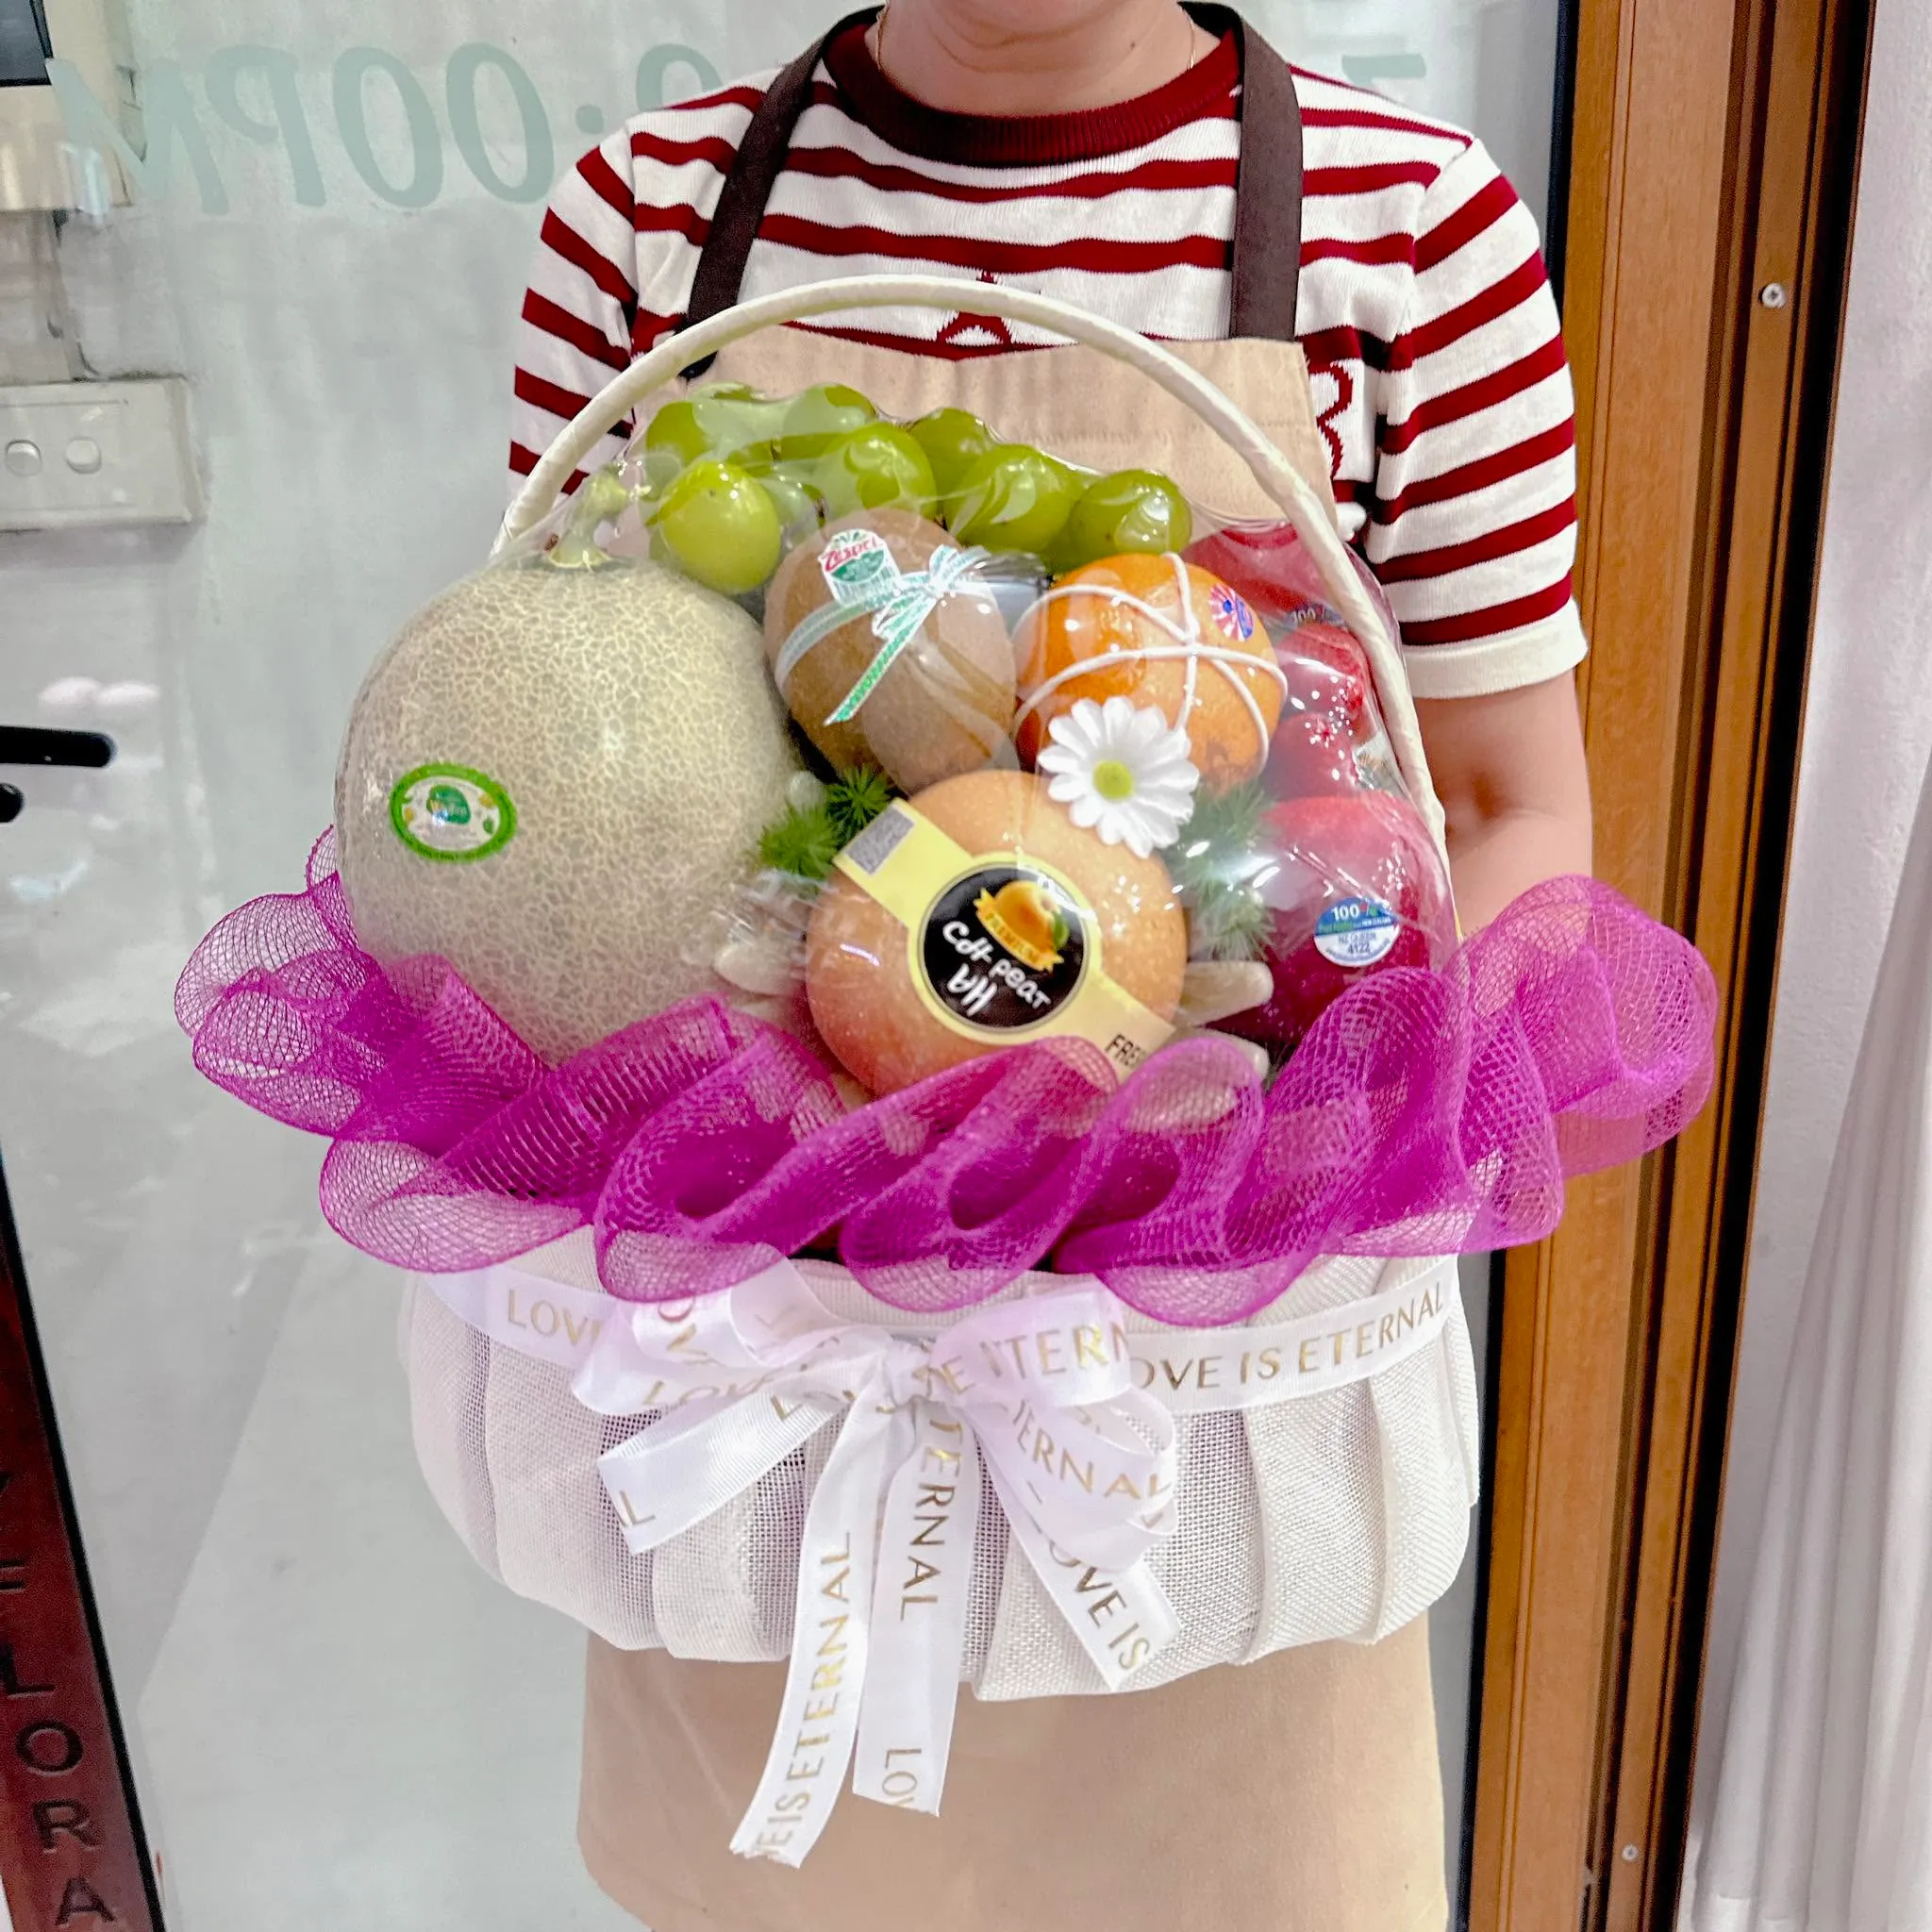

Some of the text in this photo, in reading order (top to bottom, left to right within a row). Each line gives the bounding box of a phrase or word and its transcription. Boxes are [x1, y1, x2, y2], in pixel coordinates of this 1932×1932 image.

[508, 1289, 603, 1348] LOV
[1131, 1281, 1444, 1391] OVE IS ETERNAL
[900, 1415, 963, 1622] TERNAL
[786, 1531, 852, 1782] ETERNAL
[1108, 1622, 1151, 1671] IS
[767, 1793, 812, 1824] IS
